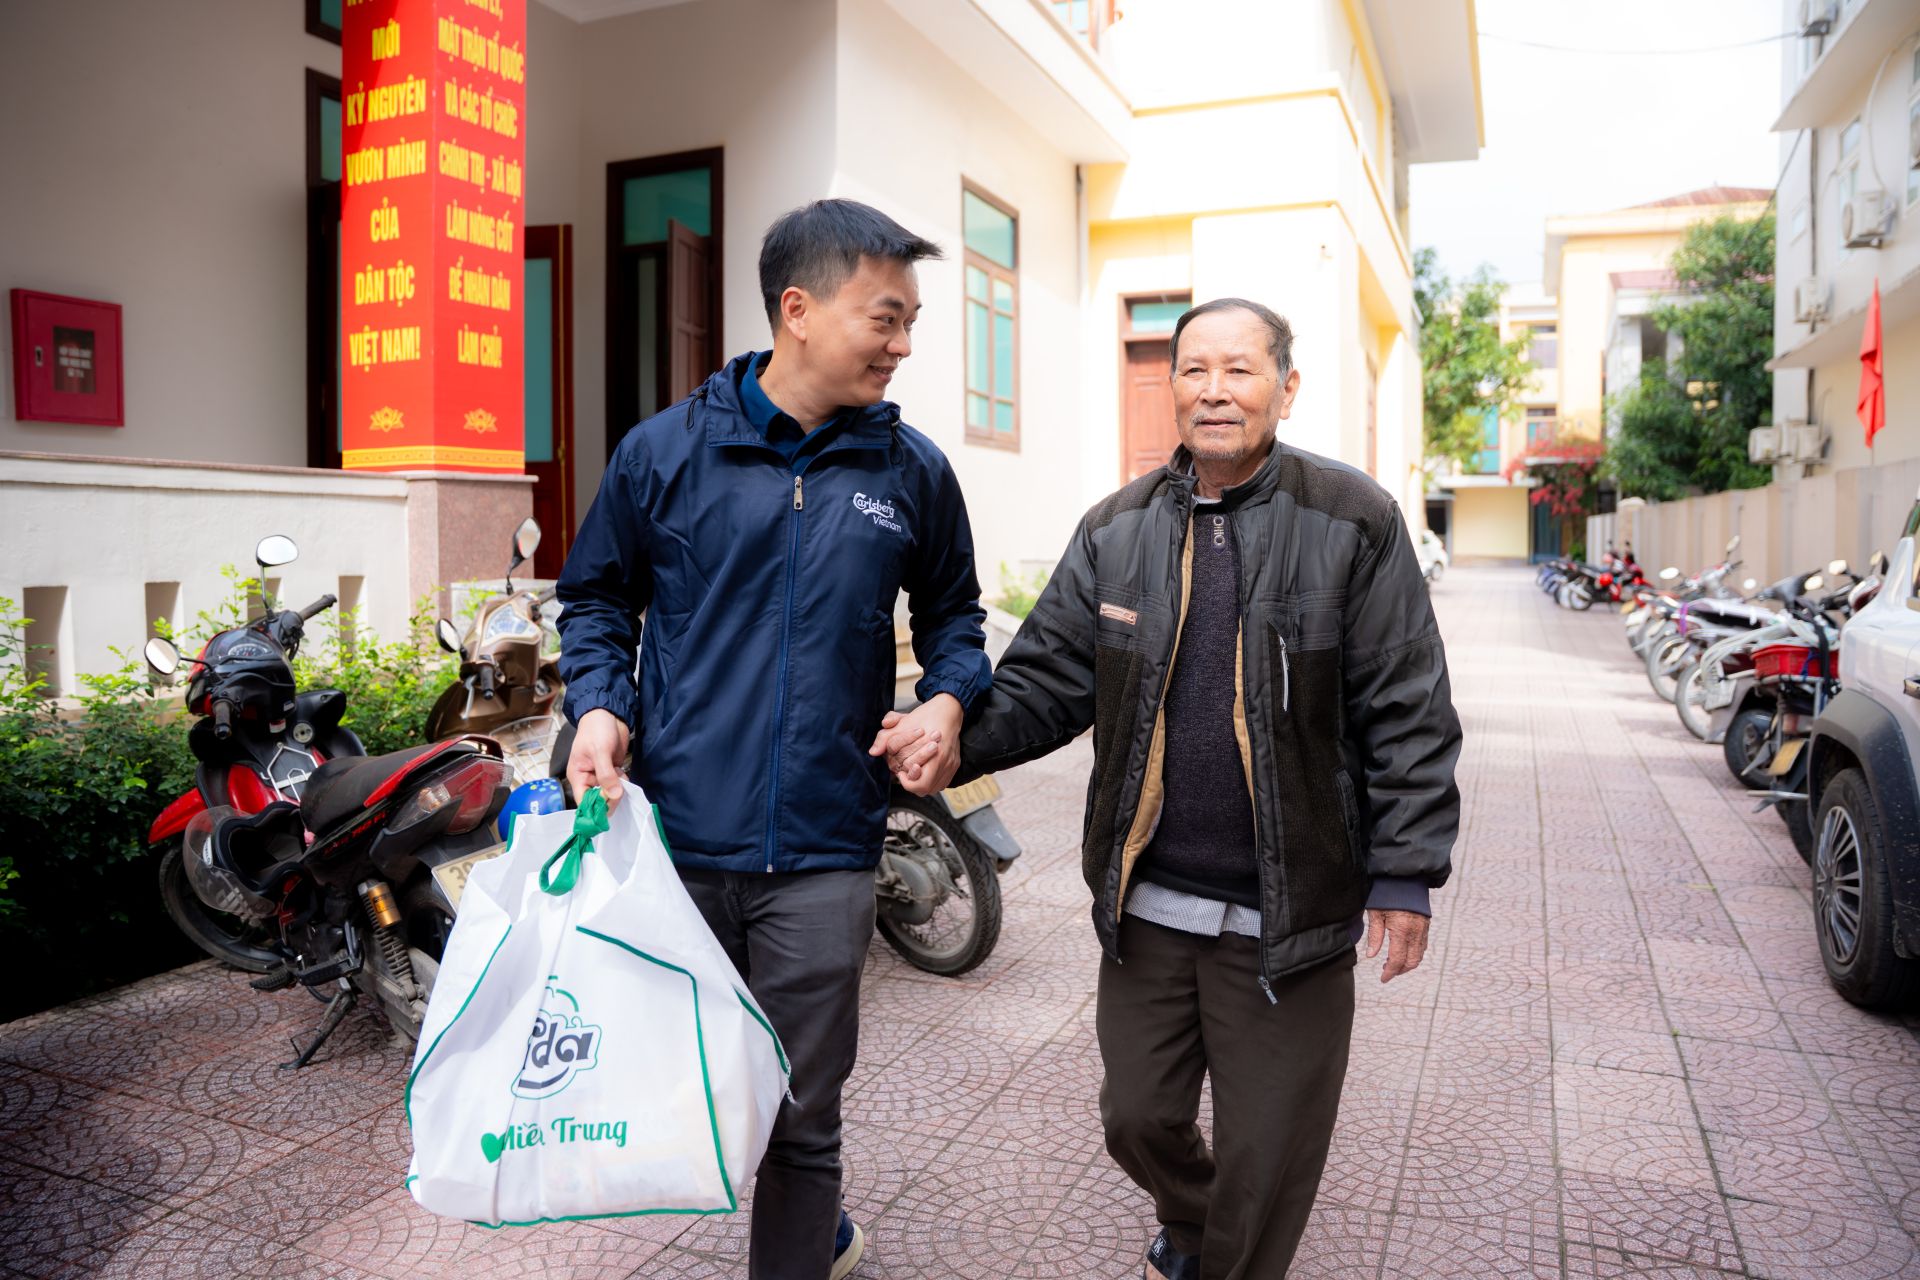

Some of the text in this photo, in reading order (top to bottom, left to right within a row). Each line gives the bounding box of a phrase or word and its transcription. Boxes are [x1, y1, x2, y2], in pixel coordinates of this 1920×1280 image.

[372, 18, 400, 61] MỚI
[347, 73, 426, 126] KỶ NGUYÊN
[445, 77, 459, 118] VÀ
[460, 83, 480, 126] CÁC
[346, 136, 426, 187] VƯƠN MÌNH
[439, 138, 469, 183] CHÍNH
[470, 150, 486, 195] TRỊ
[491, 155, 505, 193] XÃ
[505, 159, 522, 204] HỘI
[370, 196, 400, 243] CỦA
[446, 199, 468, 243] LÀM
[355, 259, 415, 308] DÂN TỘC
[349, 324, 421, 373] VIỆT NAM!
[458, 323, 479, 366] LÀM
[853, 492, 895, 518] Carlsberg
[873, 515, 902, 533] Vietnam
[551, 1116, 628, 1148] Trung
